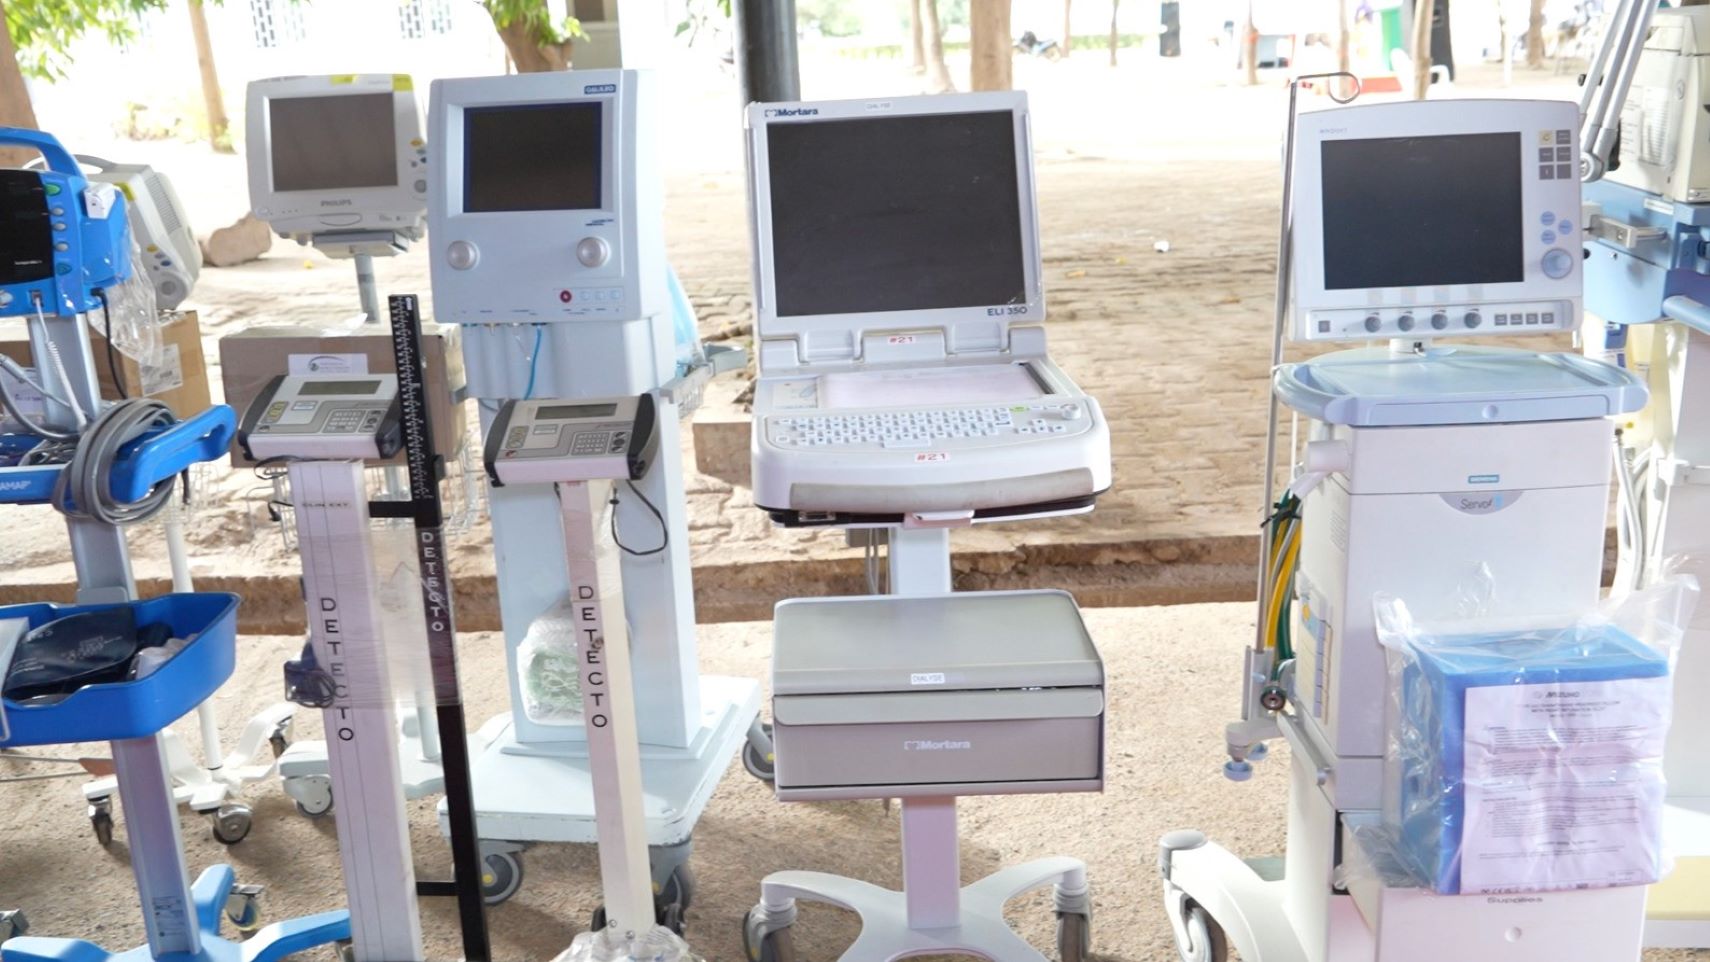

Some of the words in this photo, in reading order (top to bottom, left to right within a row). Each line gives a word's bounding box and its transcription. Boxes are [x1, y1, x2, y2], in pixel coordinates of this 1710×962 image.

[778, 108, 818, 117] Mortara
[987, 308, 1004, 317] ELI
[1008, 306, 1028, 315] 350
[889, 336, 913, 344] #21
[916, 453, 946, 461] #21
[421, 531, 445, 632] DETECTO
[578, 585, 608, 728] DETECTO
[320, 597, 354, 742] DETECTO
[921, 740, 970, 750] Mortara
